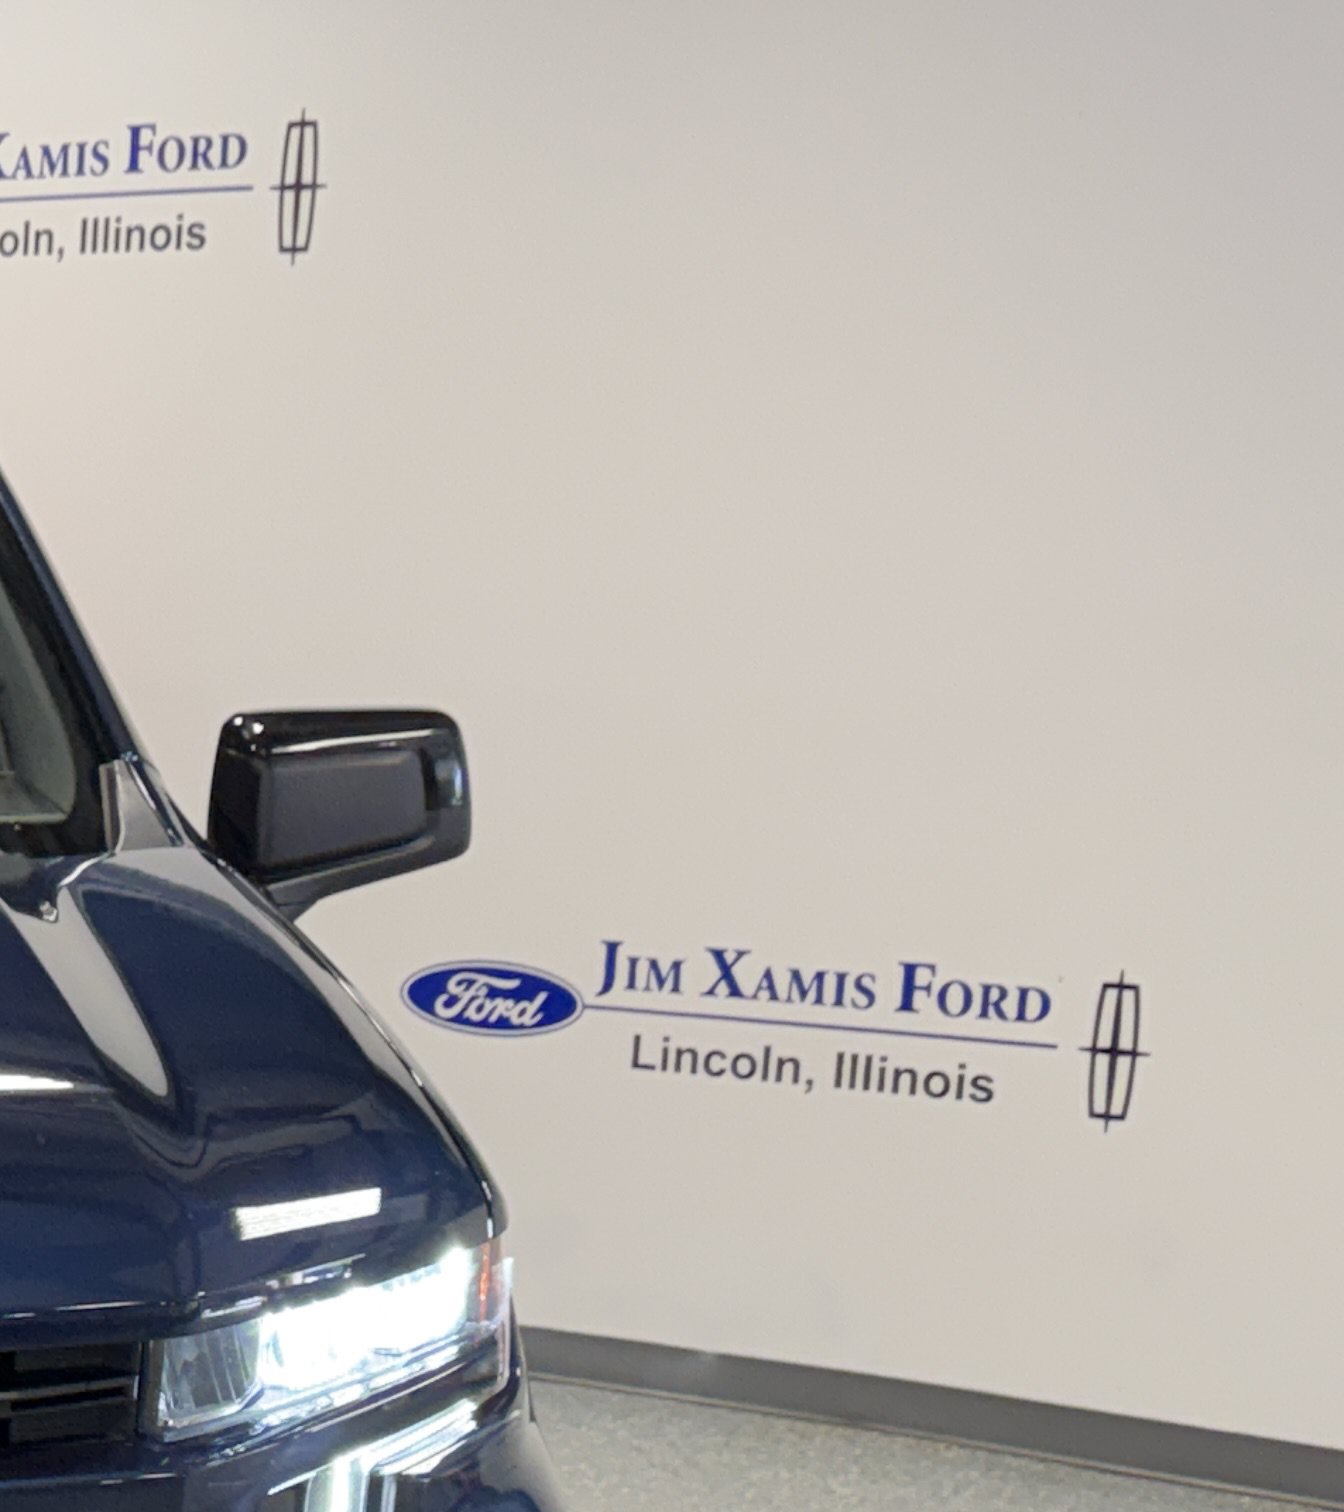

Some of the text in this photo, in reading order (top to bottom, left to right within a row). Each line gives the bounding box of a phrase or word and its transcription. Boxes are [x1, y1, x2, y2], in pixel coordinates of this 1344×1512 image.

[125, 123, 248, 176] FORD
[78, 214, 206, 255] Illinois
[432, 970, 545, 1030] Ford
[595, 940, 1052, 1024] JIM XAMIS FORD
[629, 1034, 996, 1104] Lincoln, Illinois
